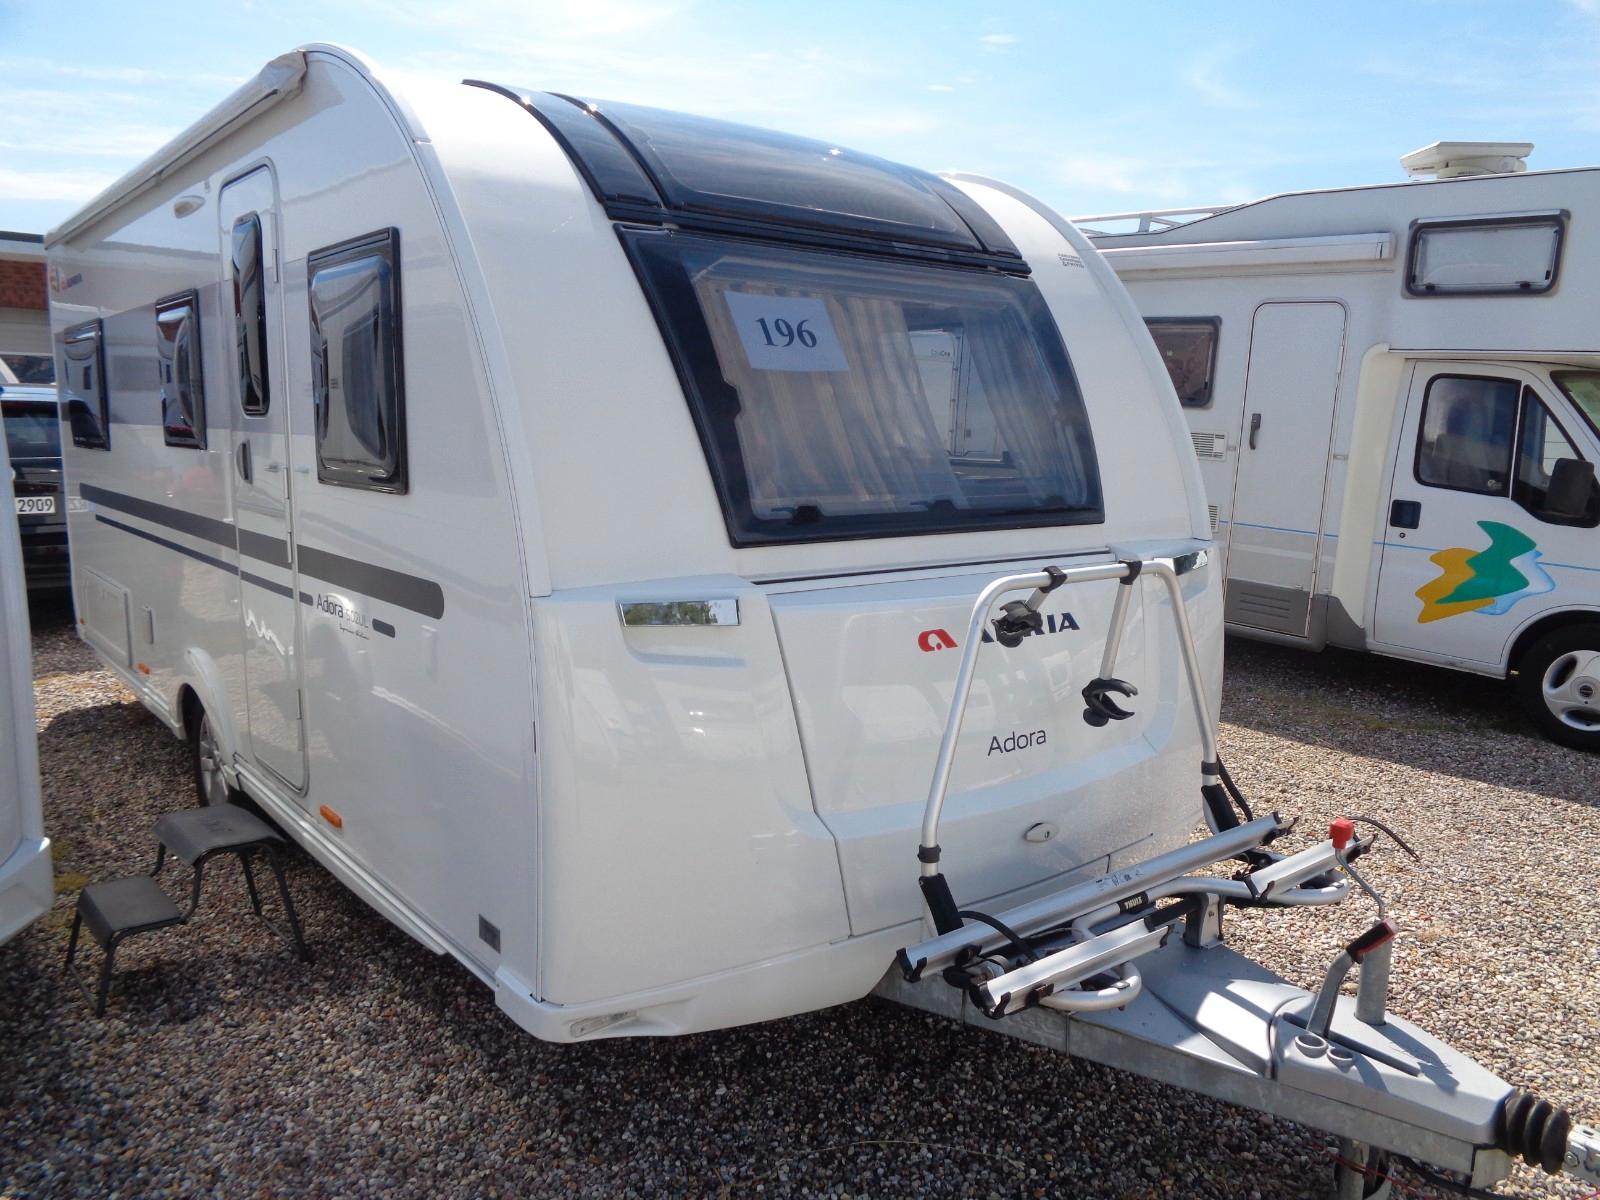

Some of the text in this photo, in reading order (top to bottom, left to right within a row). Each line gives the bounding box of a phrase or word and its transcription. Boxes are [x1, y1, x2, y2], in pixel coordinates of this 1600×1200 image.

[755, 317, 818, 349] 196
[17, 498, 53, 513] 2909
[316, 593, 344, 618] Adora
[987, 728, 1047, 757] Adora
